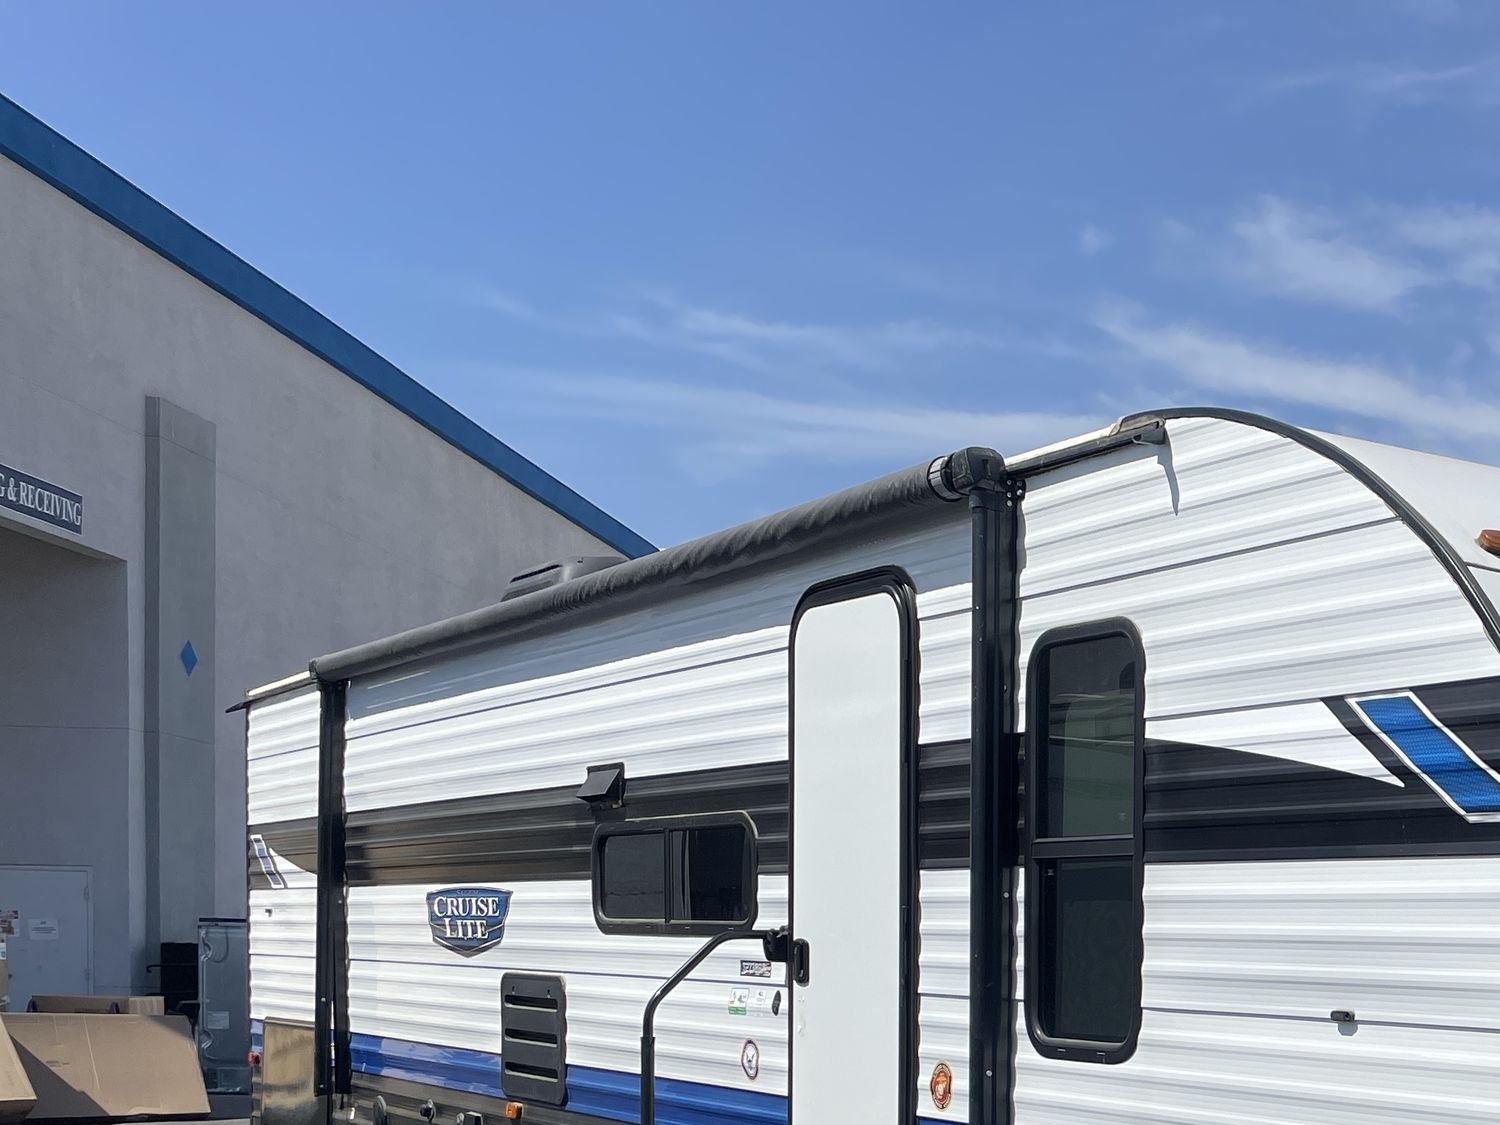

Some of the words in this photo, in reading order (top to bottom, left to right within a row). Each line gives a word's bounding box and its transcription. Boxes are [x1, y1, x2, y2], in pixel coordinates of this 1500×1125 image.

[7, 477, 18, 502] &
[17, 480, 82, 526] RECEIVING
[433, 895, 500, 917] CRUISE
[442, 917, 489, 940] LITE
